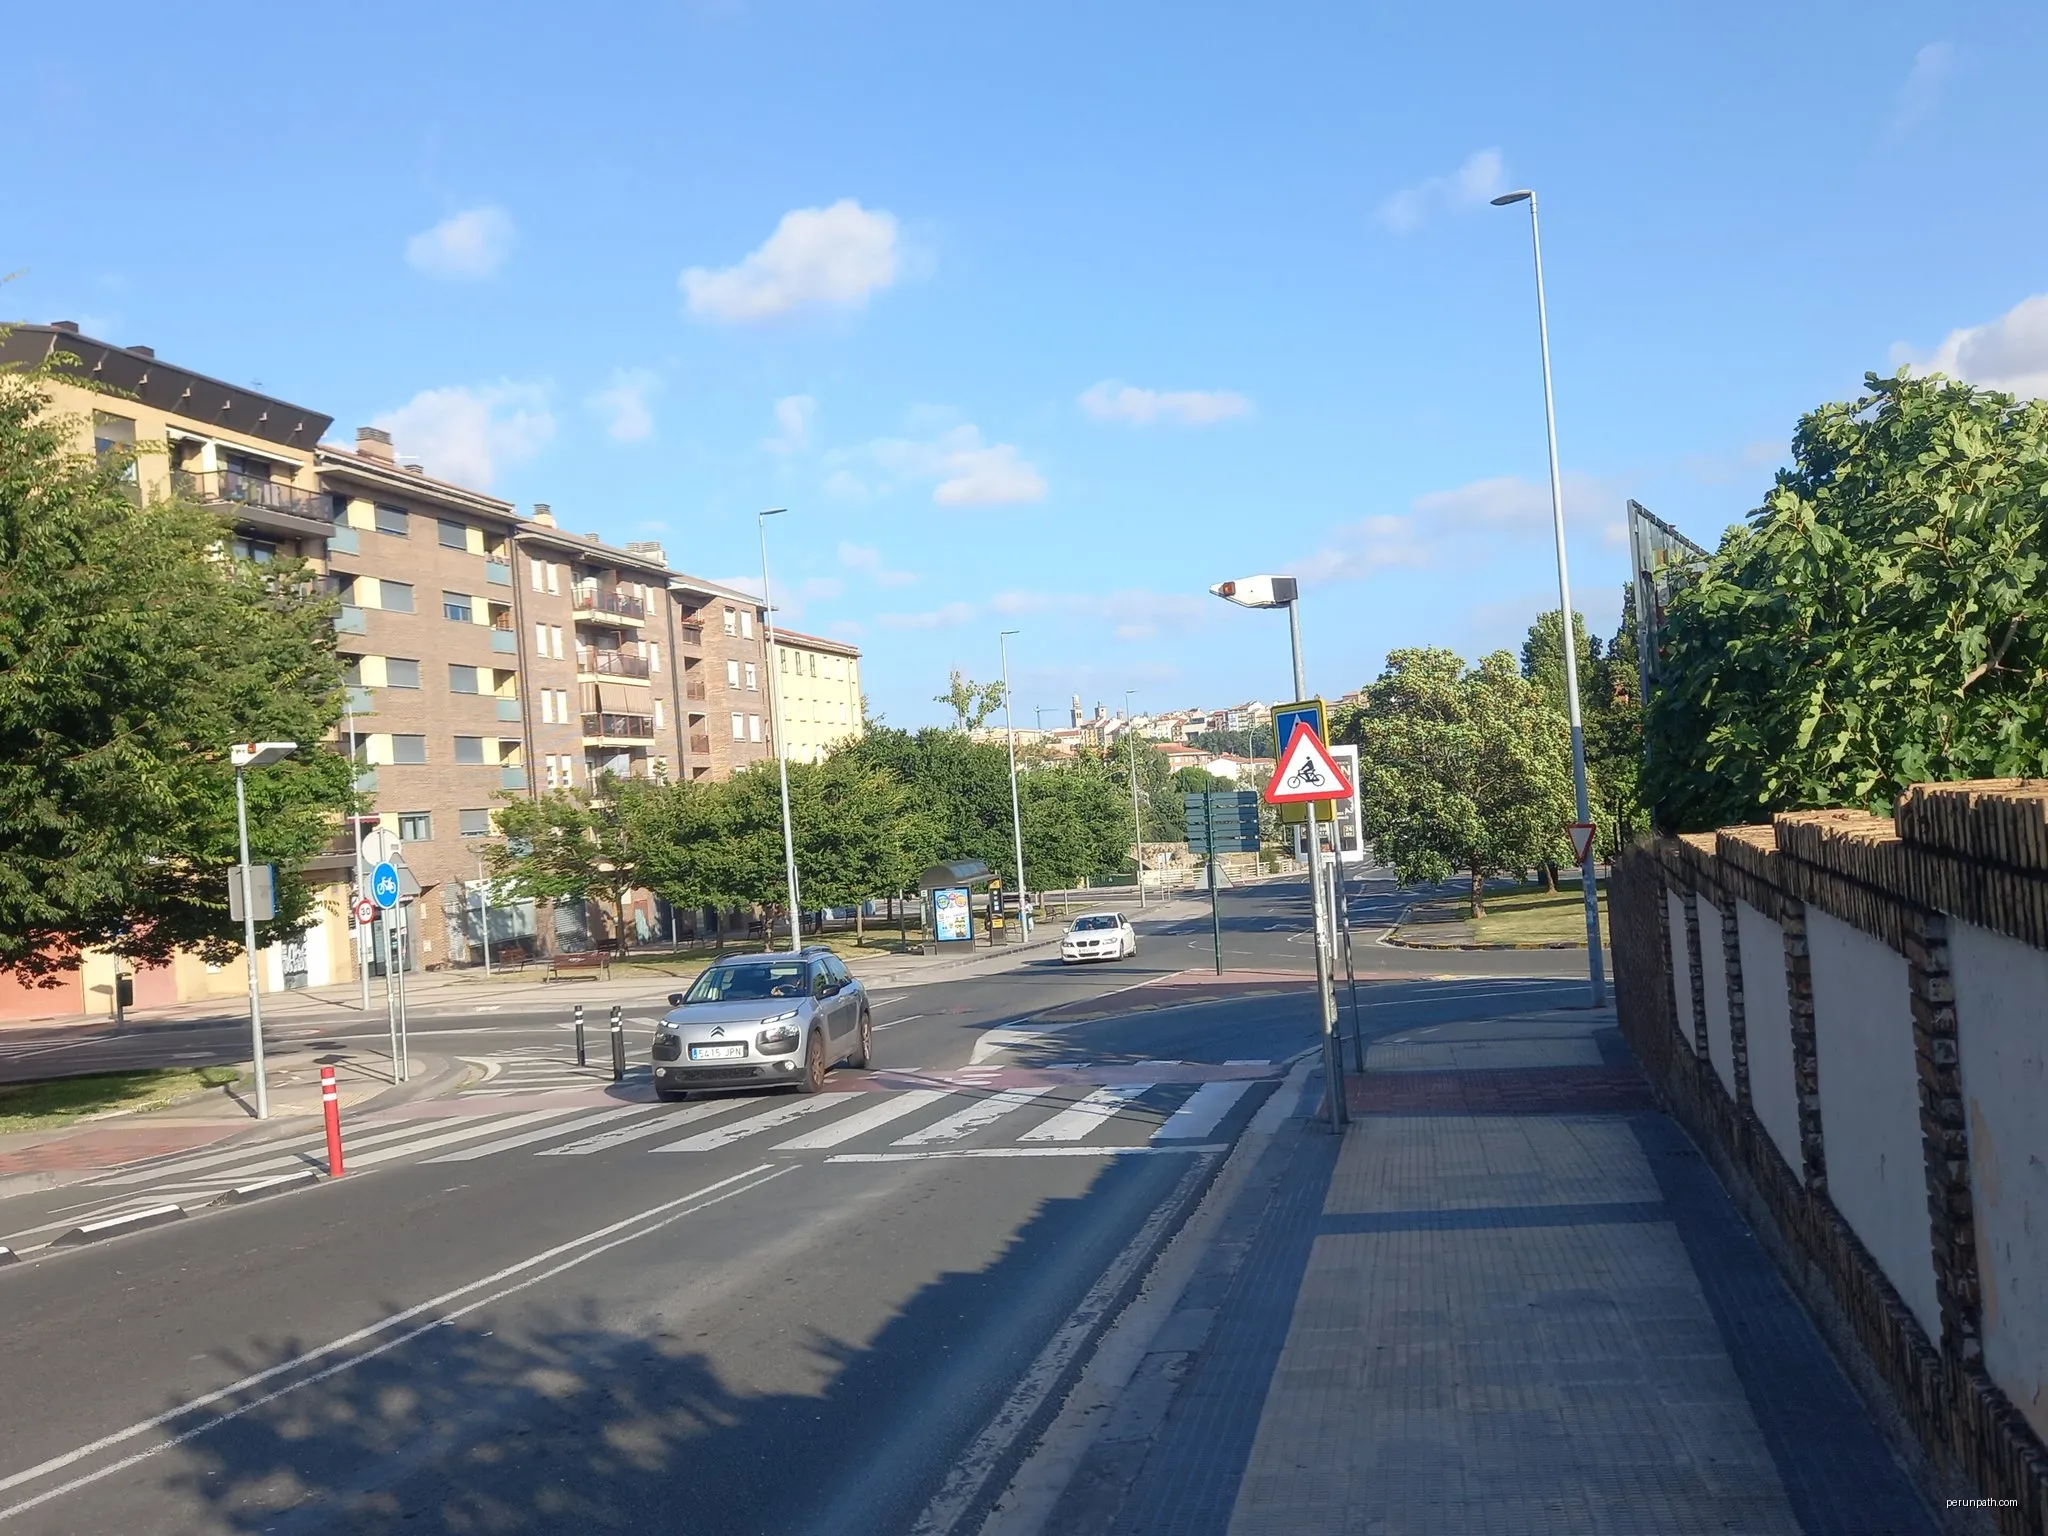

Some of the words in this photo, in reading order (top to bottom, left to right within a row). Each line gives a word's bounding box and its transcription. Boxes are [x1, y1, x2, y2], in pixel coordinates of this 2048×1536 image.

[361, 907, 370, 915] 30
[698, 1049, 720, 1058] 5415
[725, 1047, 741, 1057] JPN
